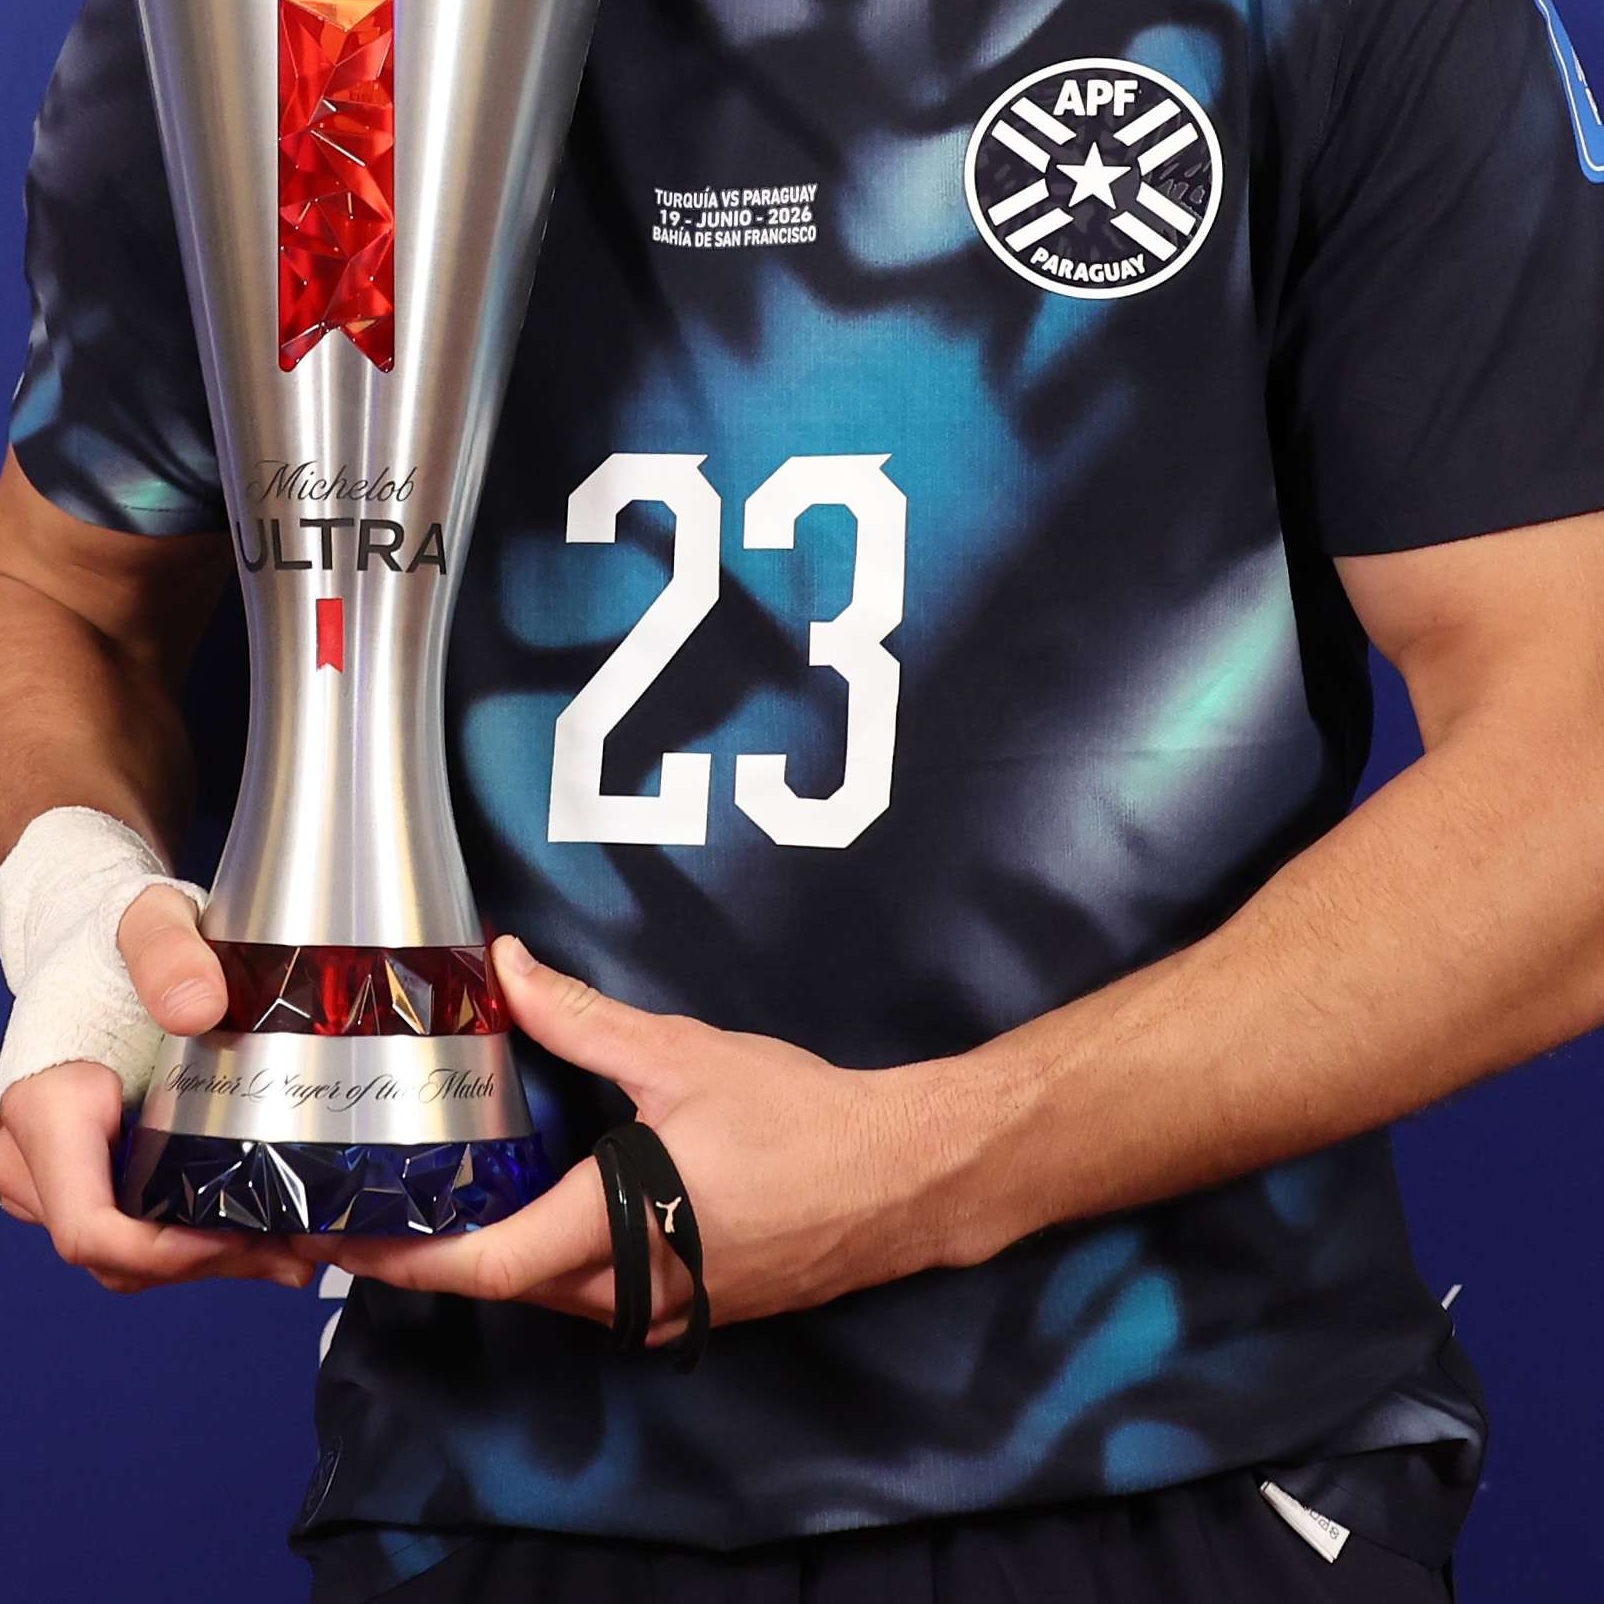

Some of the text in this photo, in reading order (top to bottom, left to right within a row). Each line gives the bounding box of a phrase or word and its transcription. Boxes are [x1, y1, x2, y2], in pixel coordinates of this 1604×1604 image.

[1053, 79, 1138, 116] APF
[654, 183, 817, 208] TURQUÍA VS PARAGUAY
[660, 210, 680, 226] 19
[696, 210, 751, 227] JUNIO
[768, 206, 812, 224] 2026
[652, 225, 817, 247] BAHÍA DE SAN FRANCISCO
[1030, 246, 1146, 283] PARAGUAY
[247, 460, 418, 505] Michelob
[236, 518, 447, 575] ULTRA
[548, 454, 906, 847] 23
[326, 1073, 394, 1113] of
[418, 1067, 495, 1104] Match
